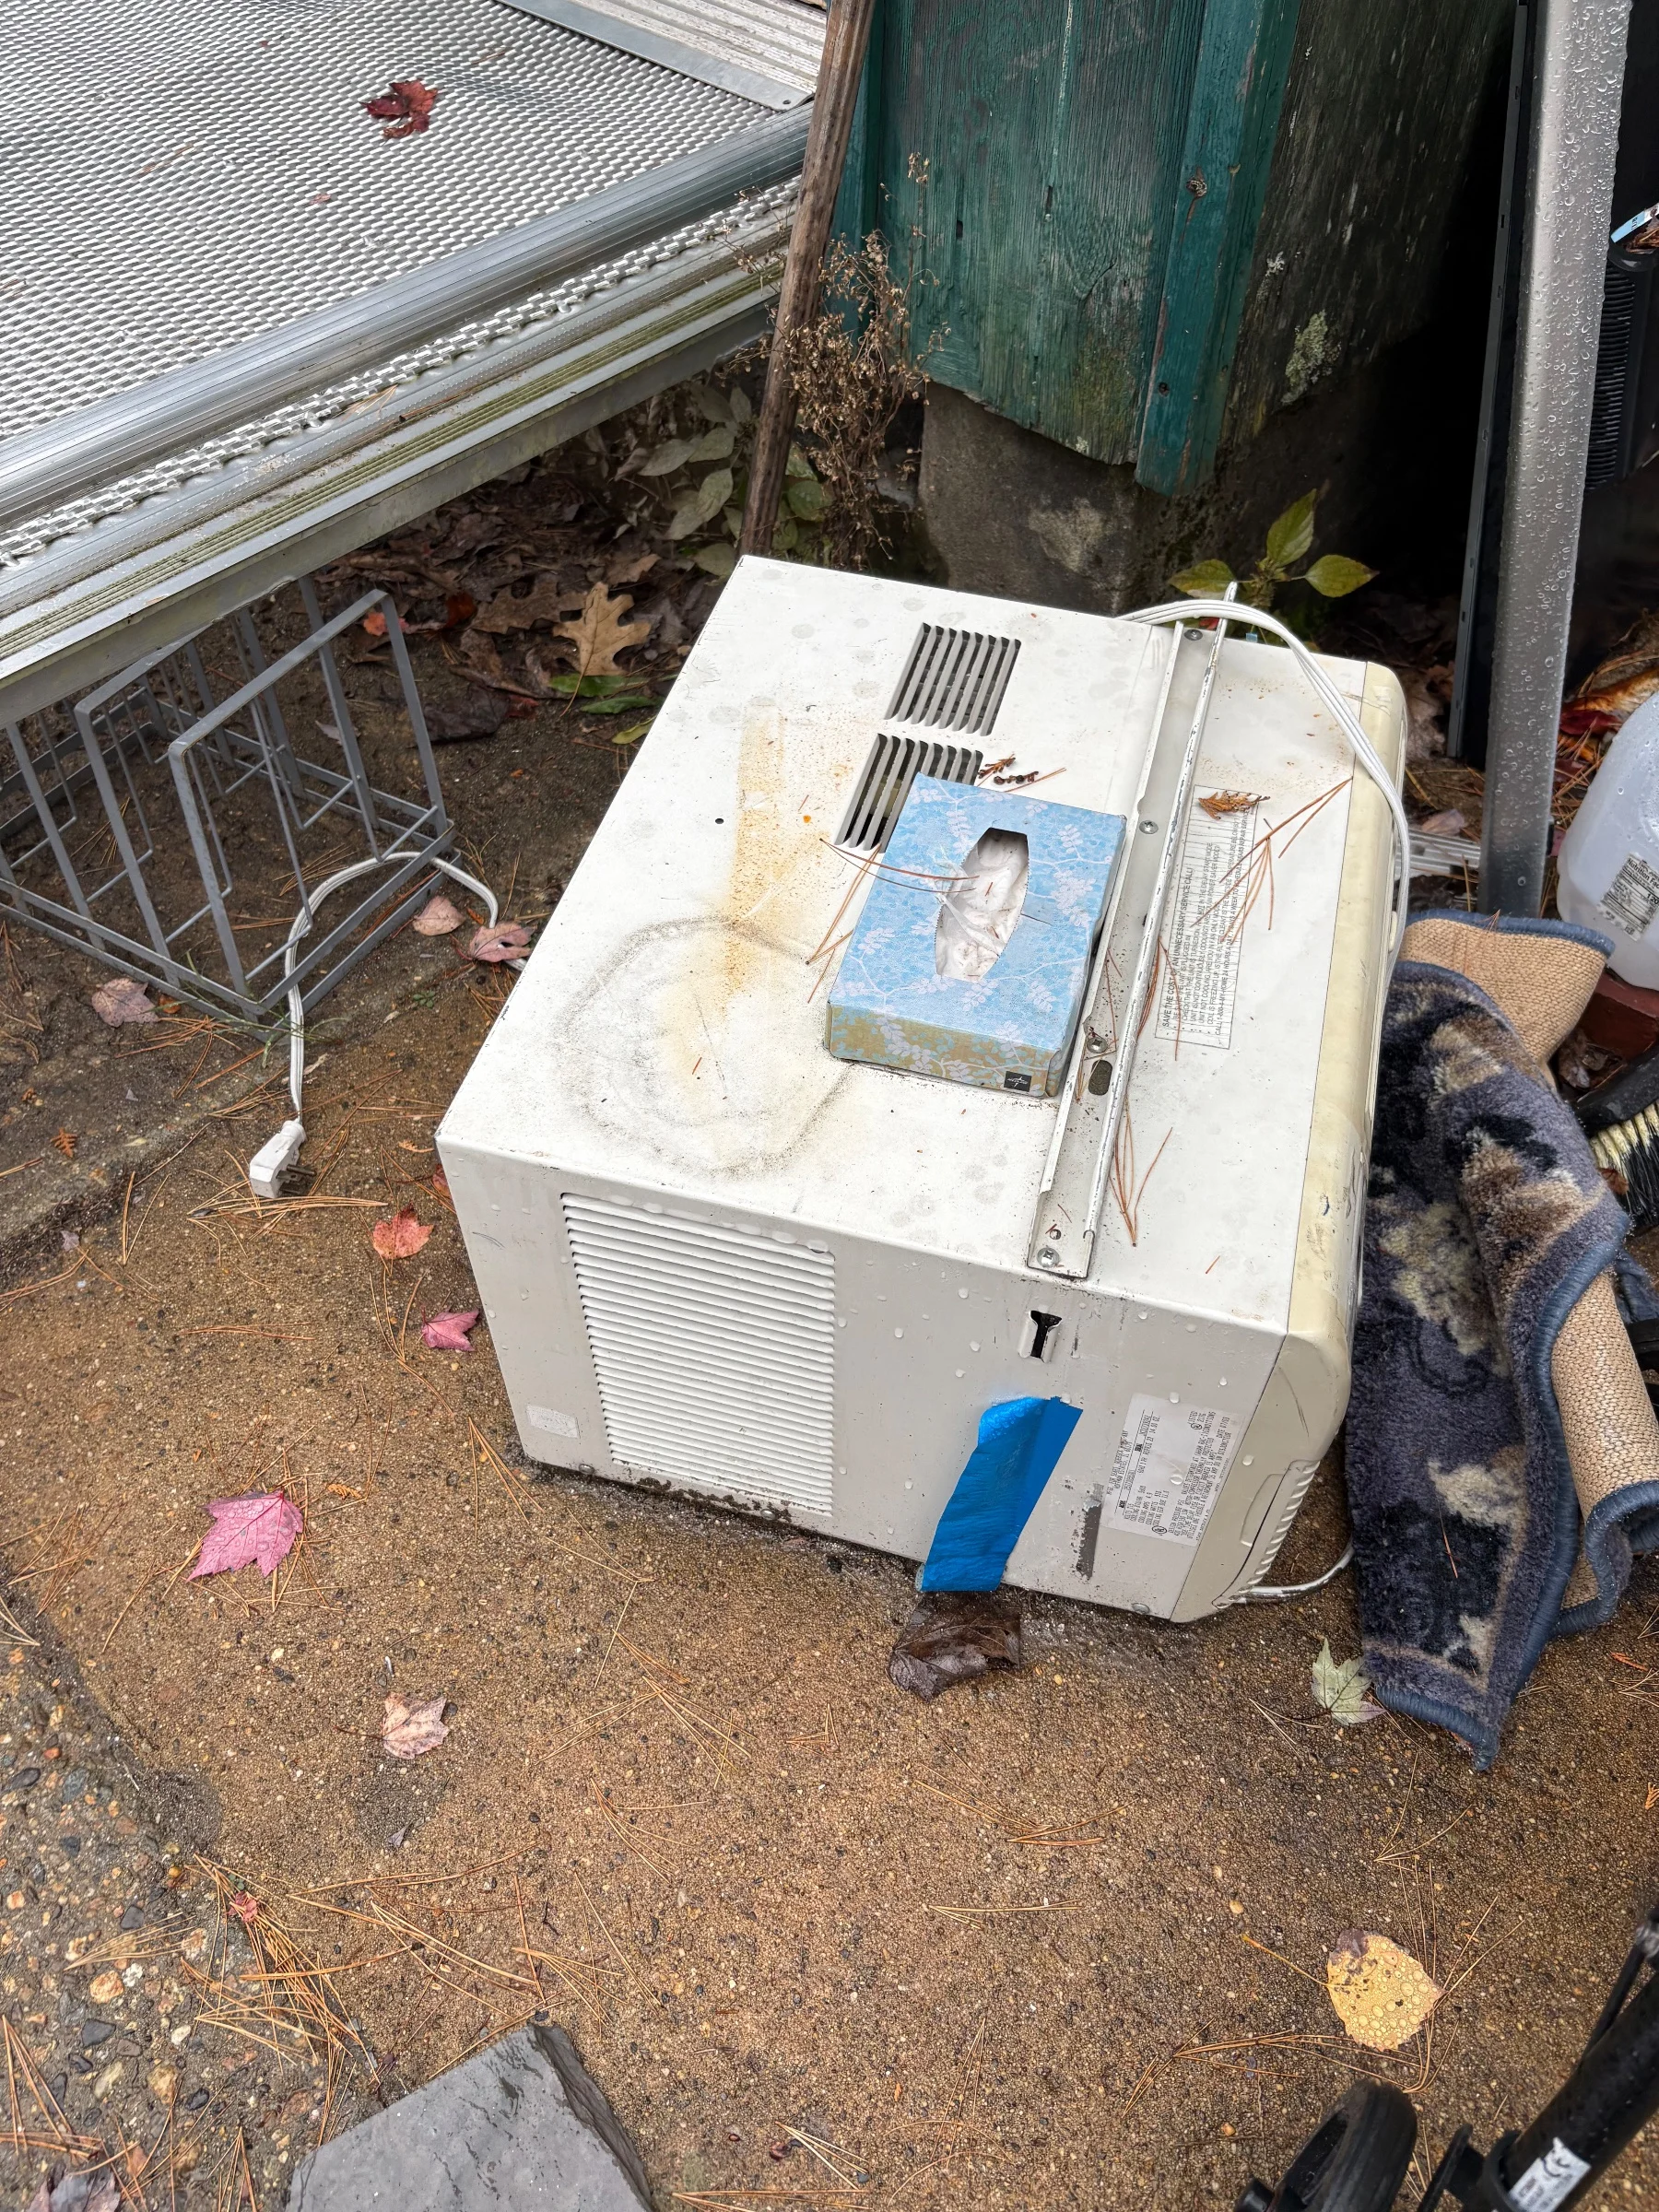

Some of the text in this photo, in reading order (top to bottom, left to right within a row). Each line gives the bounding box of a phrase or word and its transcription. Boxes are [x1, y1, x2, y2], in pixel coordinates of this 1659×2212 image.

[1183, 867, 1193, 884] CALL!
[1628, 858, 1650, 881] Nutrition
[1180, 885, 1190, 910] SERVICE
[1647, 893, 1659, 904] 120
[1172, 912, 1185, 956] UNNECESSARY
[1171, 957, 1179, 966] AN
[1181, 941, 1190, 965] PLUGGED
[1194, 950, 1205, 990] CONTINUOUSLY
[1167, 977, 1176, 994] COST
[1209, 979, 1218, 1005] FREEZING
[1164, 994, 1173, 1008] THE
[1217, 976, 1227, 1019] 1-800-4-MY-HOME
[1161, 1009, 1171, 1027] SAVE
[1181, 1001, 1189, 1020] CHECK
[1129, 1508, 1139, 1522] COOLING
[1137, 1509, 1147, 1524] COOLING
[1145, 1511, 1155, 1524] COOLING
